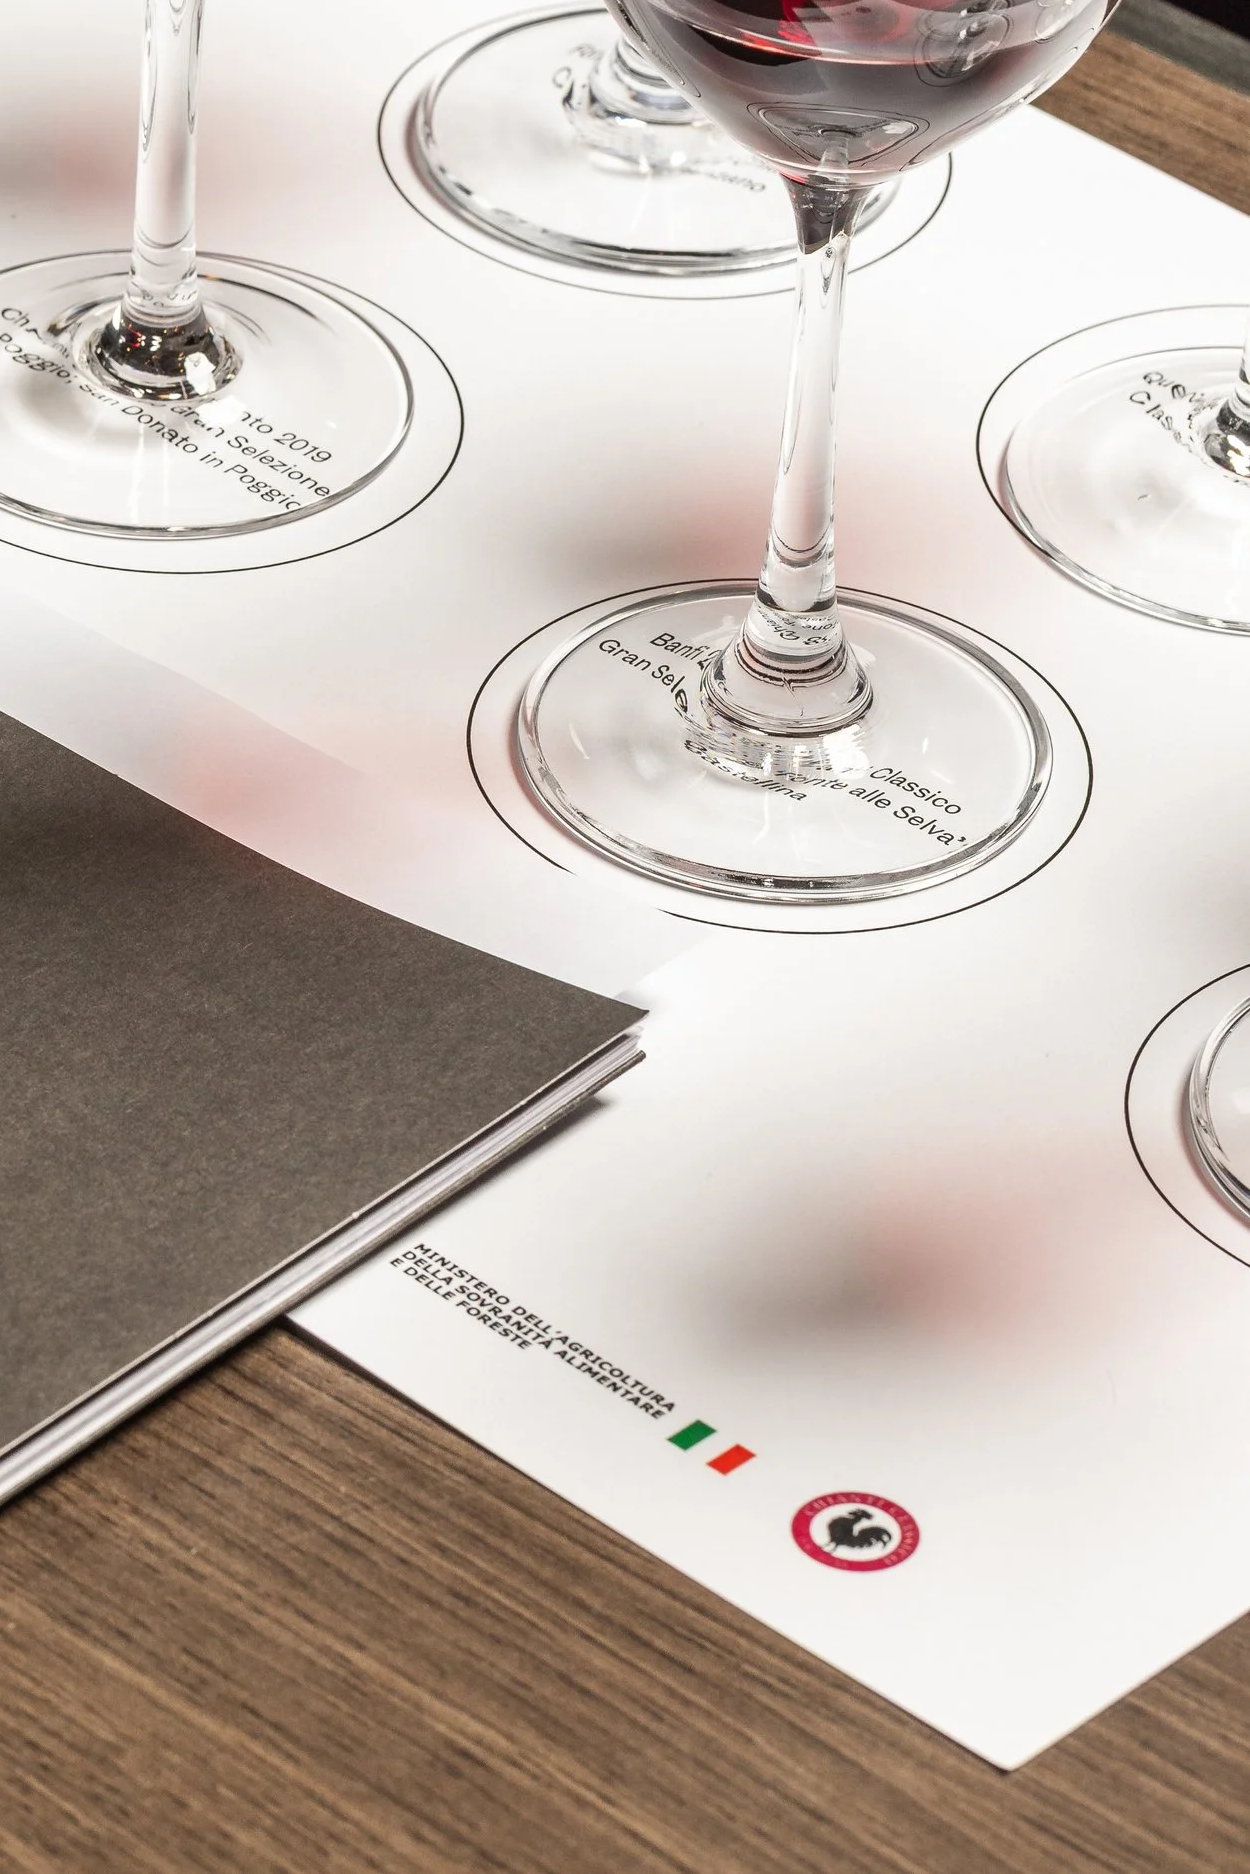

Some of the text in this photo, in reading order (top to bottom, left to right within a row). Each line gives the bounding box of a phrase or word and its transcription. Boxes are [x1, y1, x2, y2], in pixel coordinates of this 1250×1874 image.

[121, 405, 199, 455] Donato
[199, 450, 225, 469] in
[227, 435, 331, 497] Selezione
[273, 432, 333, 464] 2019
[599, 639, 652, 672] Gran
[848, 786, 892, 809] alle
[869, 767, 962, 816] Classico
[389, 1257, 533, 1351] E DELLE FORESTE
[413, 1243, 676, 1412] MINISTERO DELL'AGRICOLTURA
[401, 1250, 454, 1286] DELLA
[553, 1349, 667, 1421] ALIMENTARE
